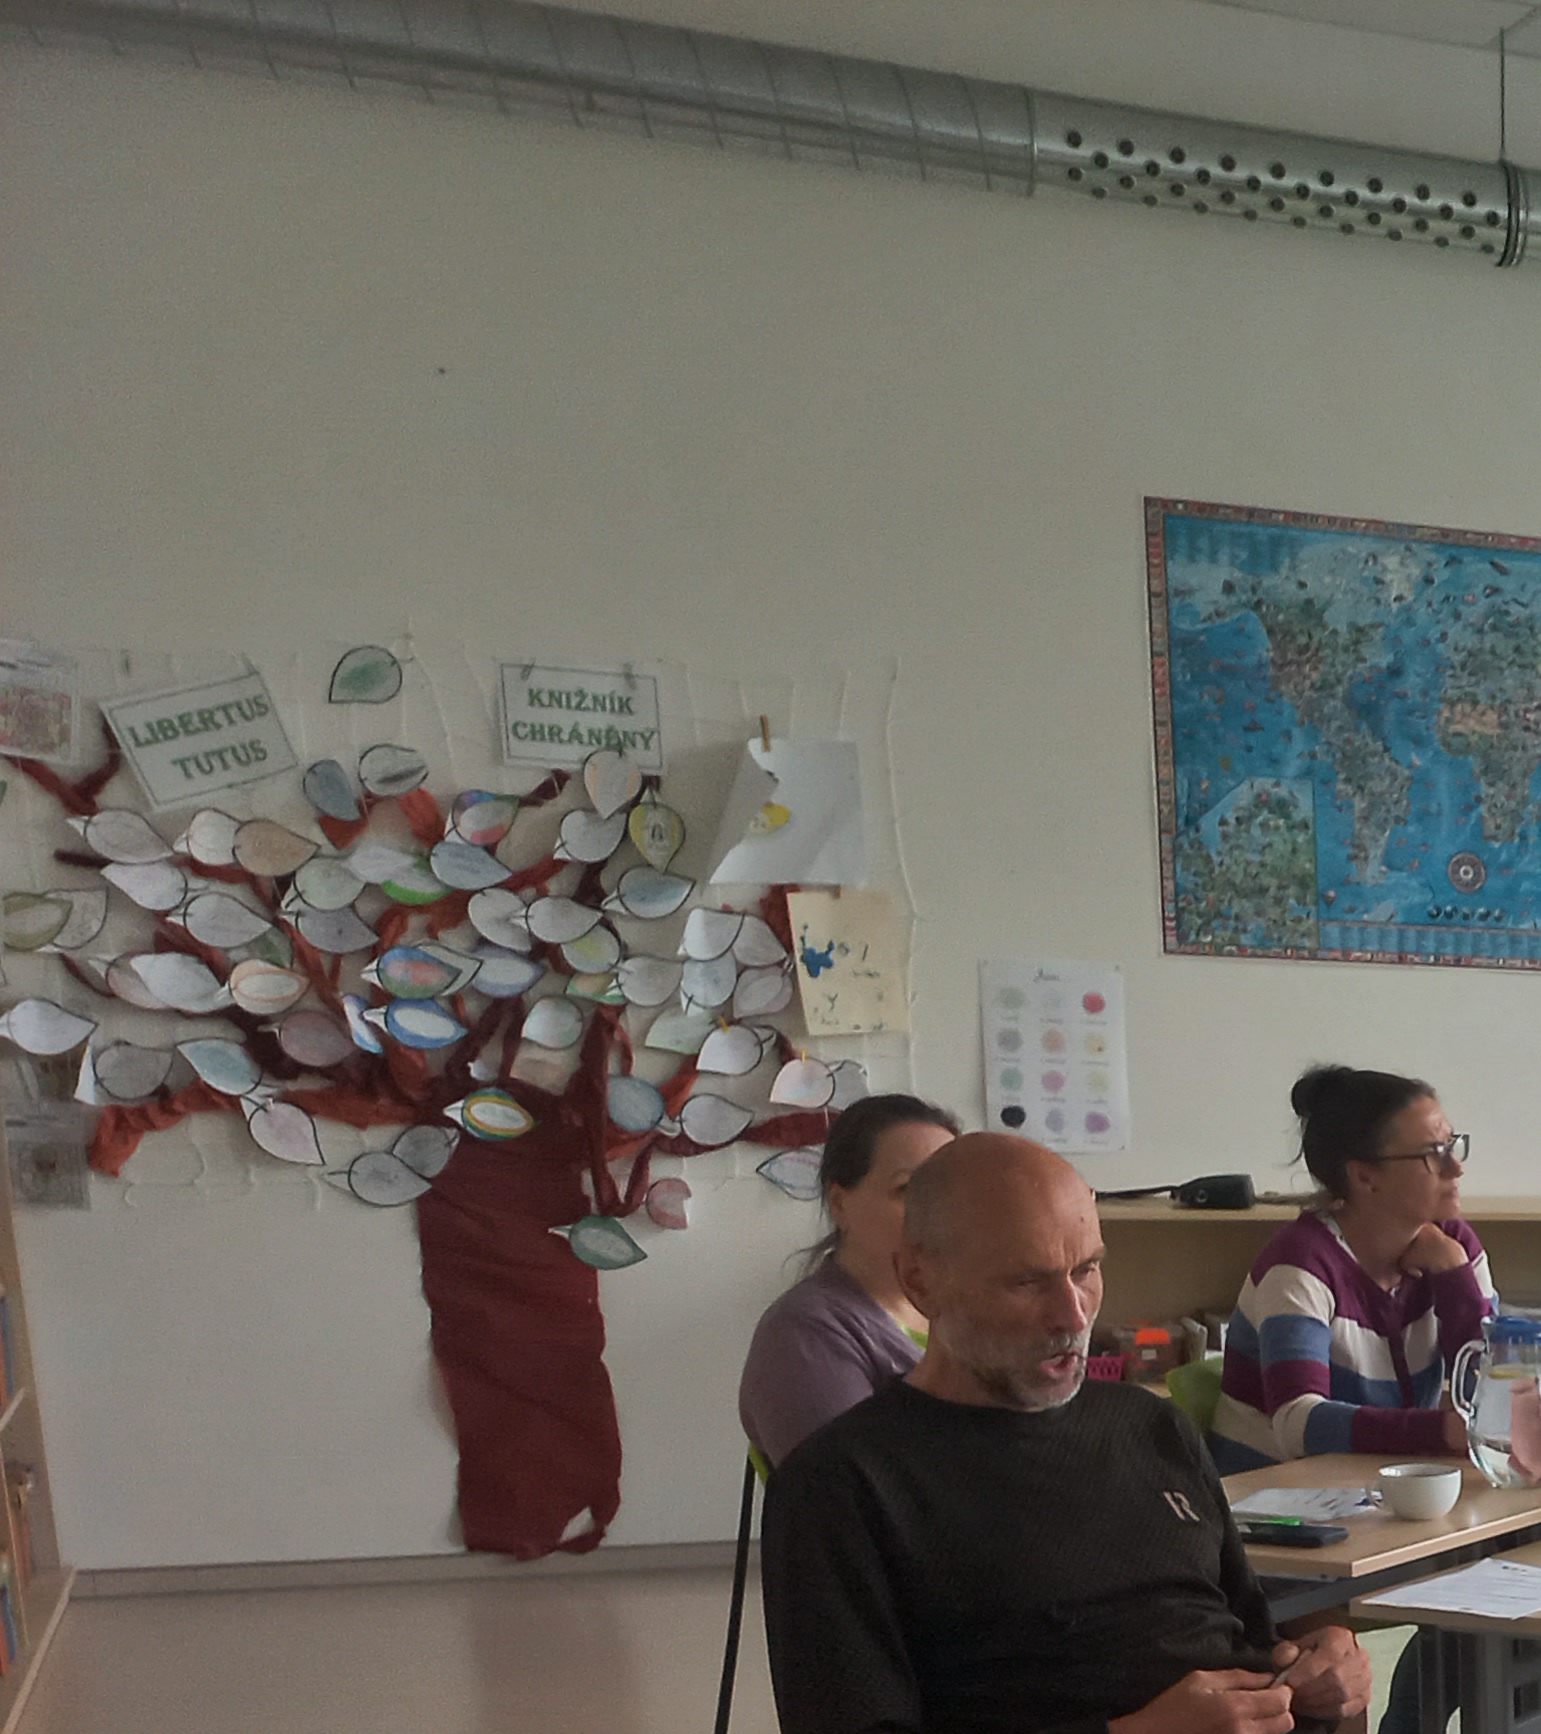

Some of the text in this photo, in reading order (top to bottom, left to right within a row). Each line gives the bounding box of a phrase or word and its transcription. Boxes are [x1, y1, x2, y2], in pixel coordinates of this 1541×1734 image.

[528, 686, 634, 715] KNIŽNÍK
[128, 694, 269, 748] LIBERTUS
[511, 721, 656, 750] CHRÁNĚNÝ
[171, 738, 268, 780] TUTUS
